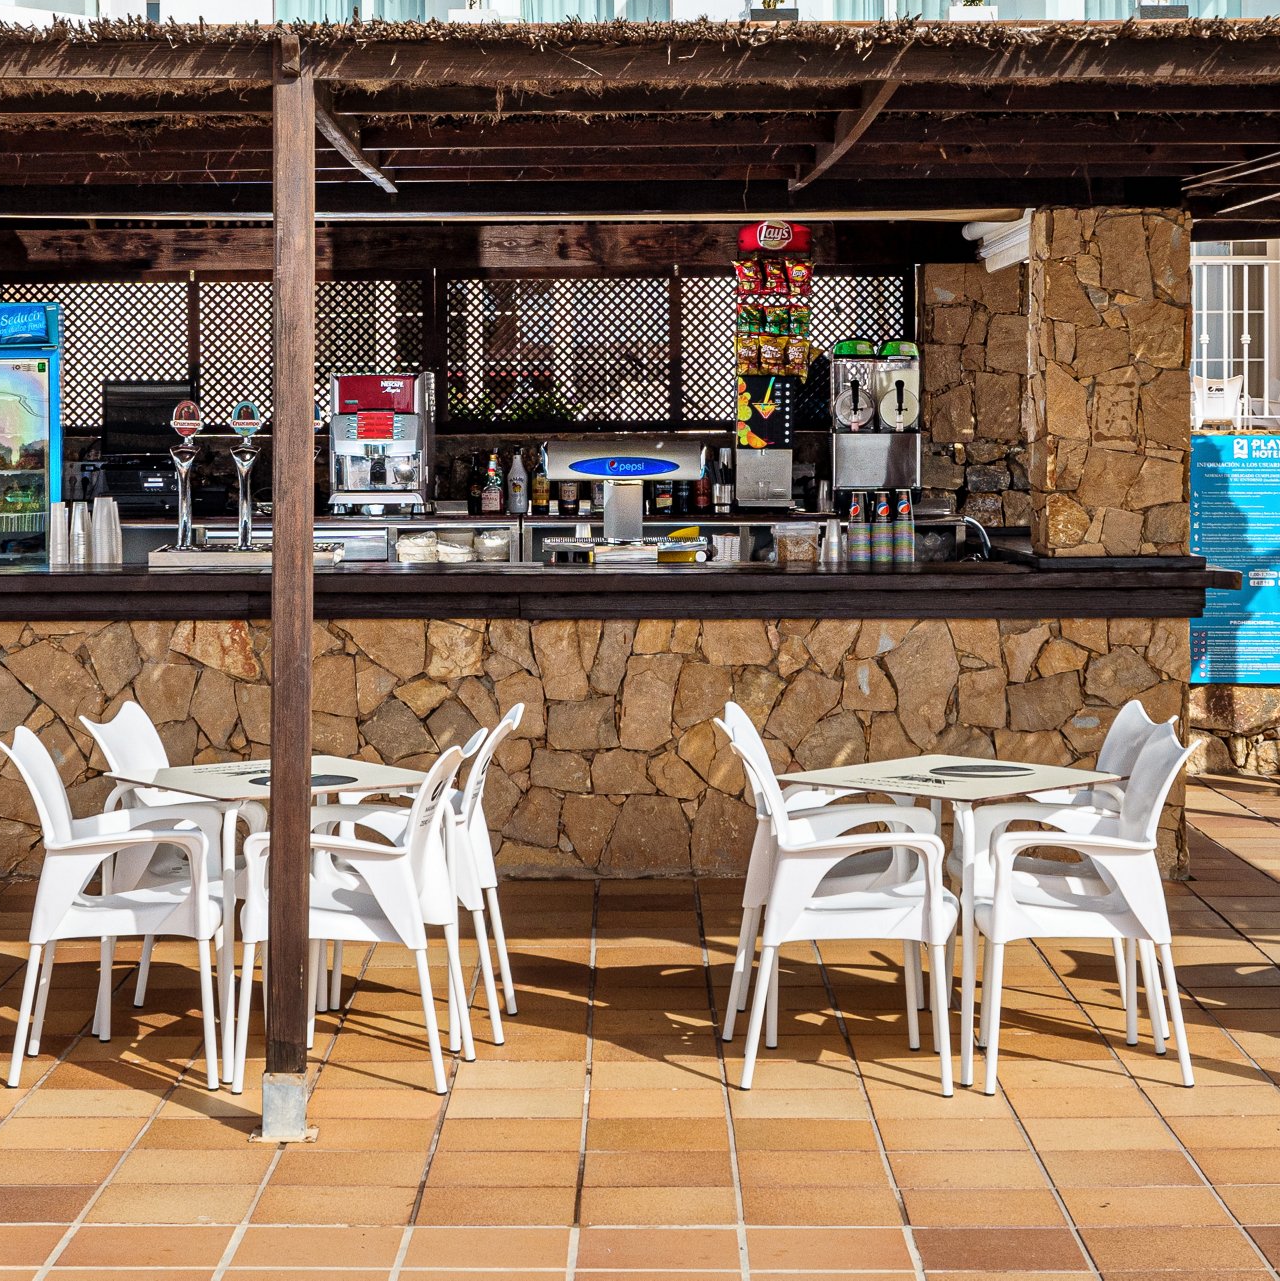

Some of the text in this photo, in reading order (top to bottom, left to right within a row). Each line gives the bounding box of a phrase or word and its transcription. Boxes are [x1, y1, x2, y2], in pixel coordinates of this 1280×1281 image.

[760, 224, 789, 240] Lay's
[0, 310, 41, 326] Seducir
[620, 462, 645, 472] pepsi
